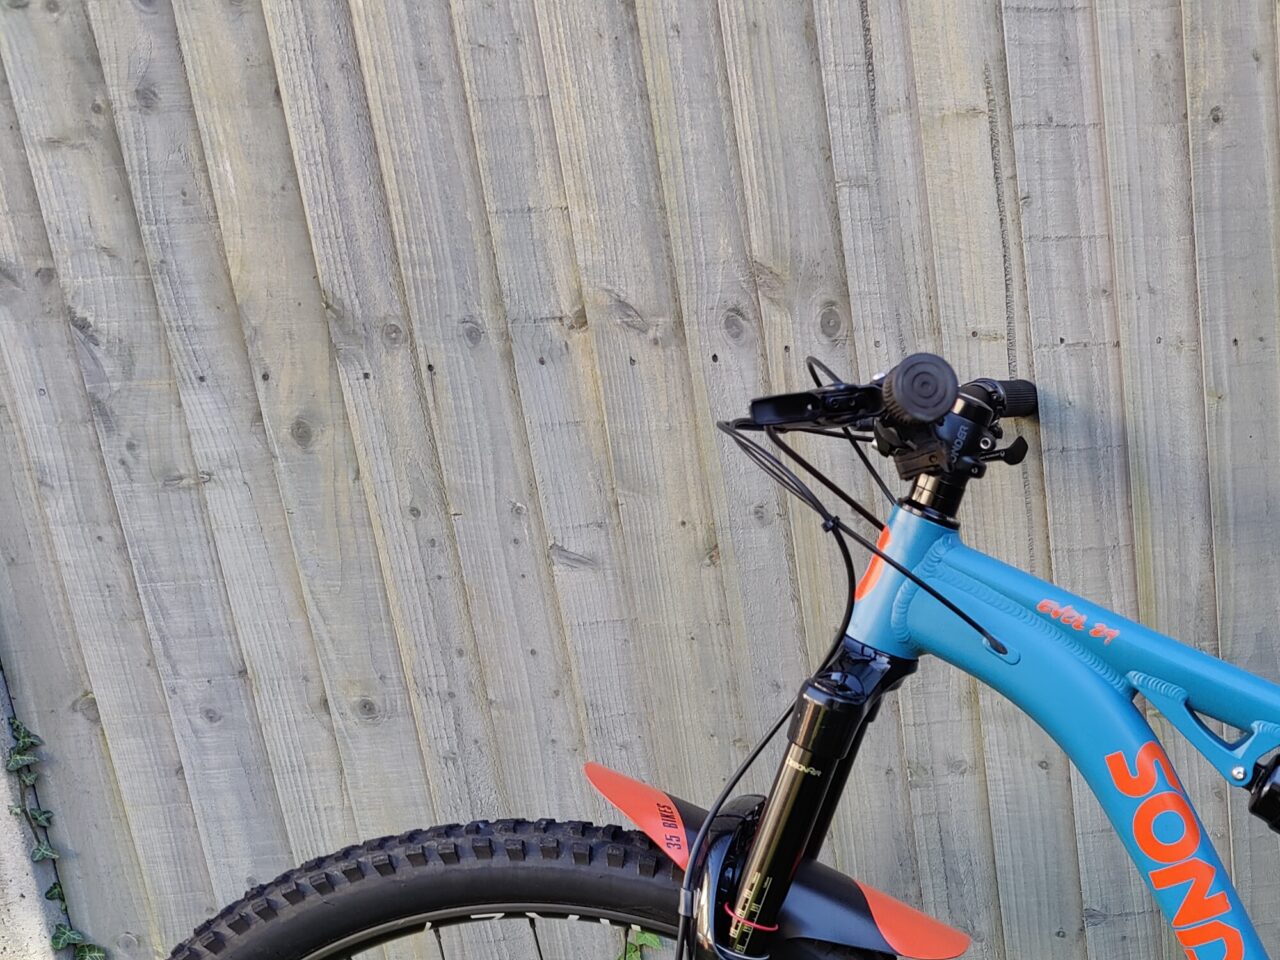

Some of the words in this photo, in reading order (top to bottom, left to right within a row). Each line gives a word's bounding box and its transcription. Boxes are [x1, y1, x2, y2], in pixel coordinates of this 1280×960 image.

[950, 425, 969, 464] ONDER
[656, 803, 679, 829] BIKES
[665, 834, 682, 850] 35
